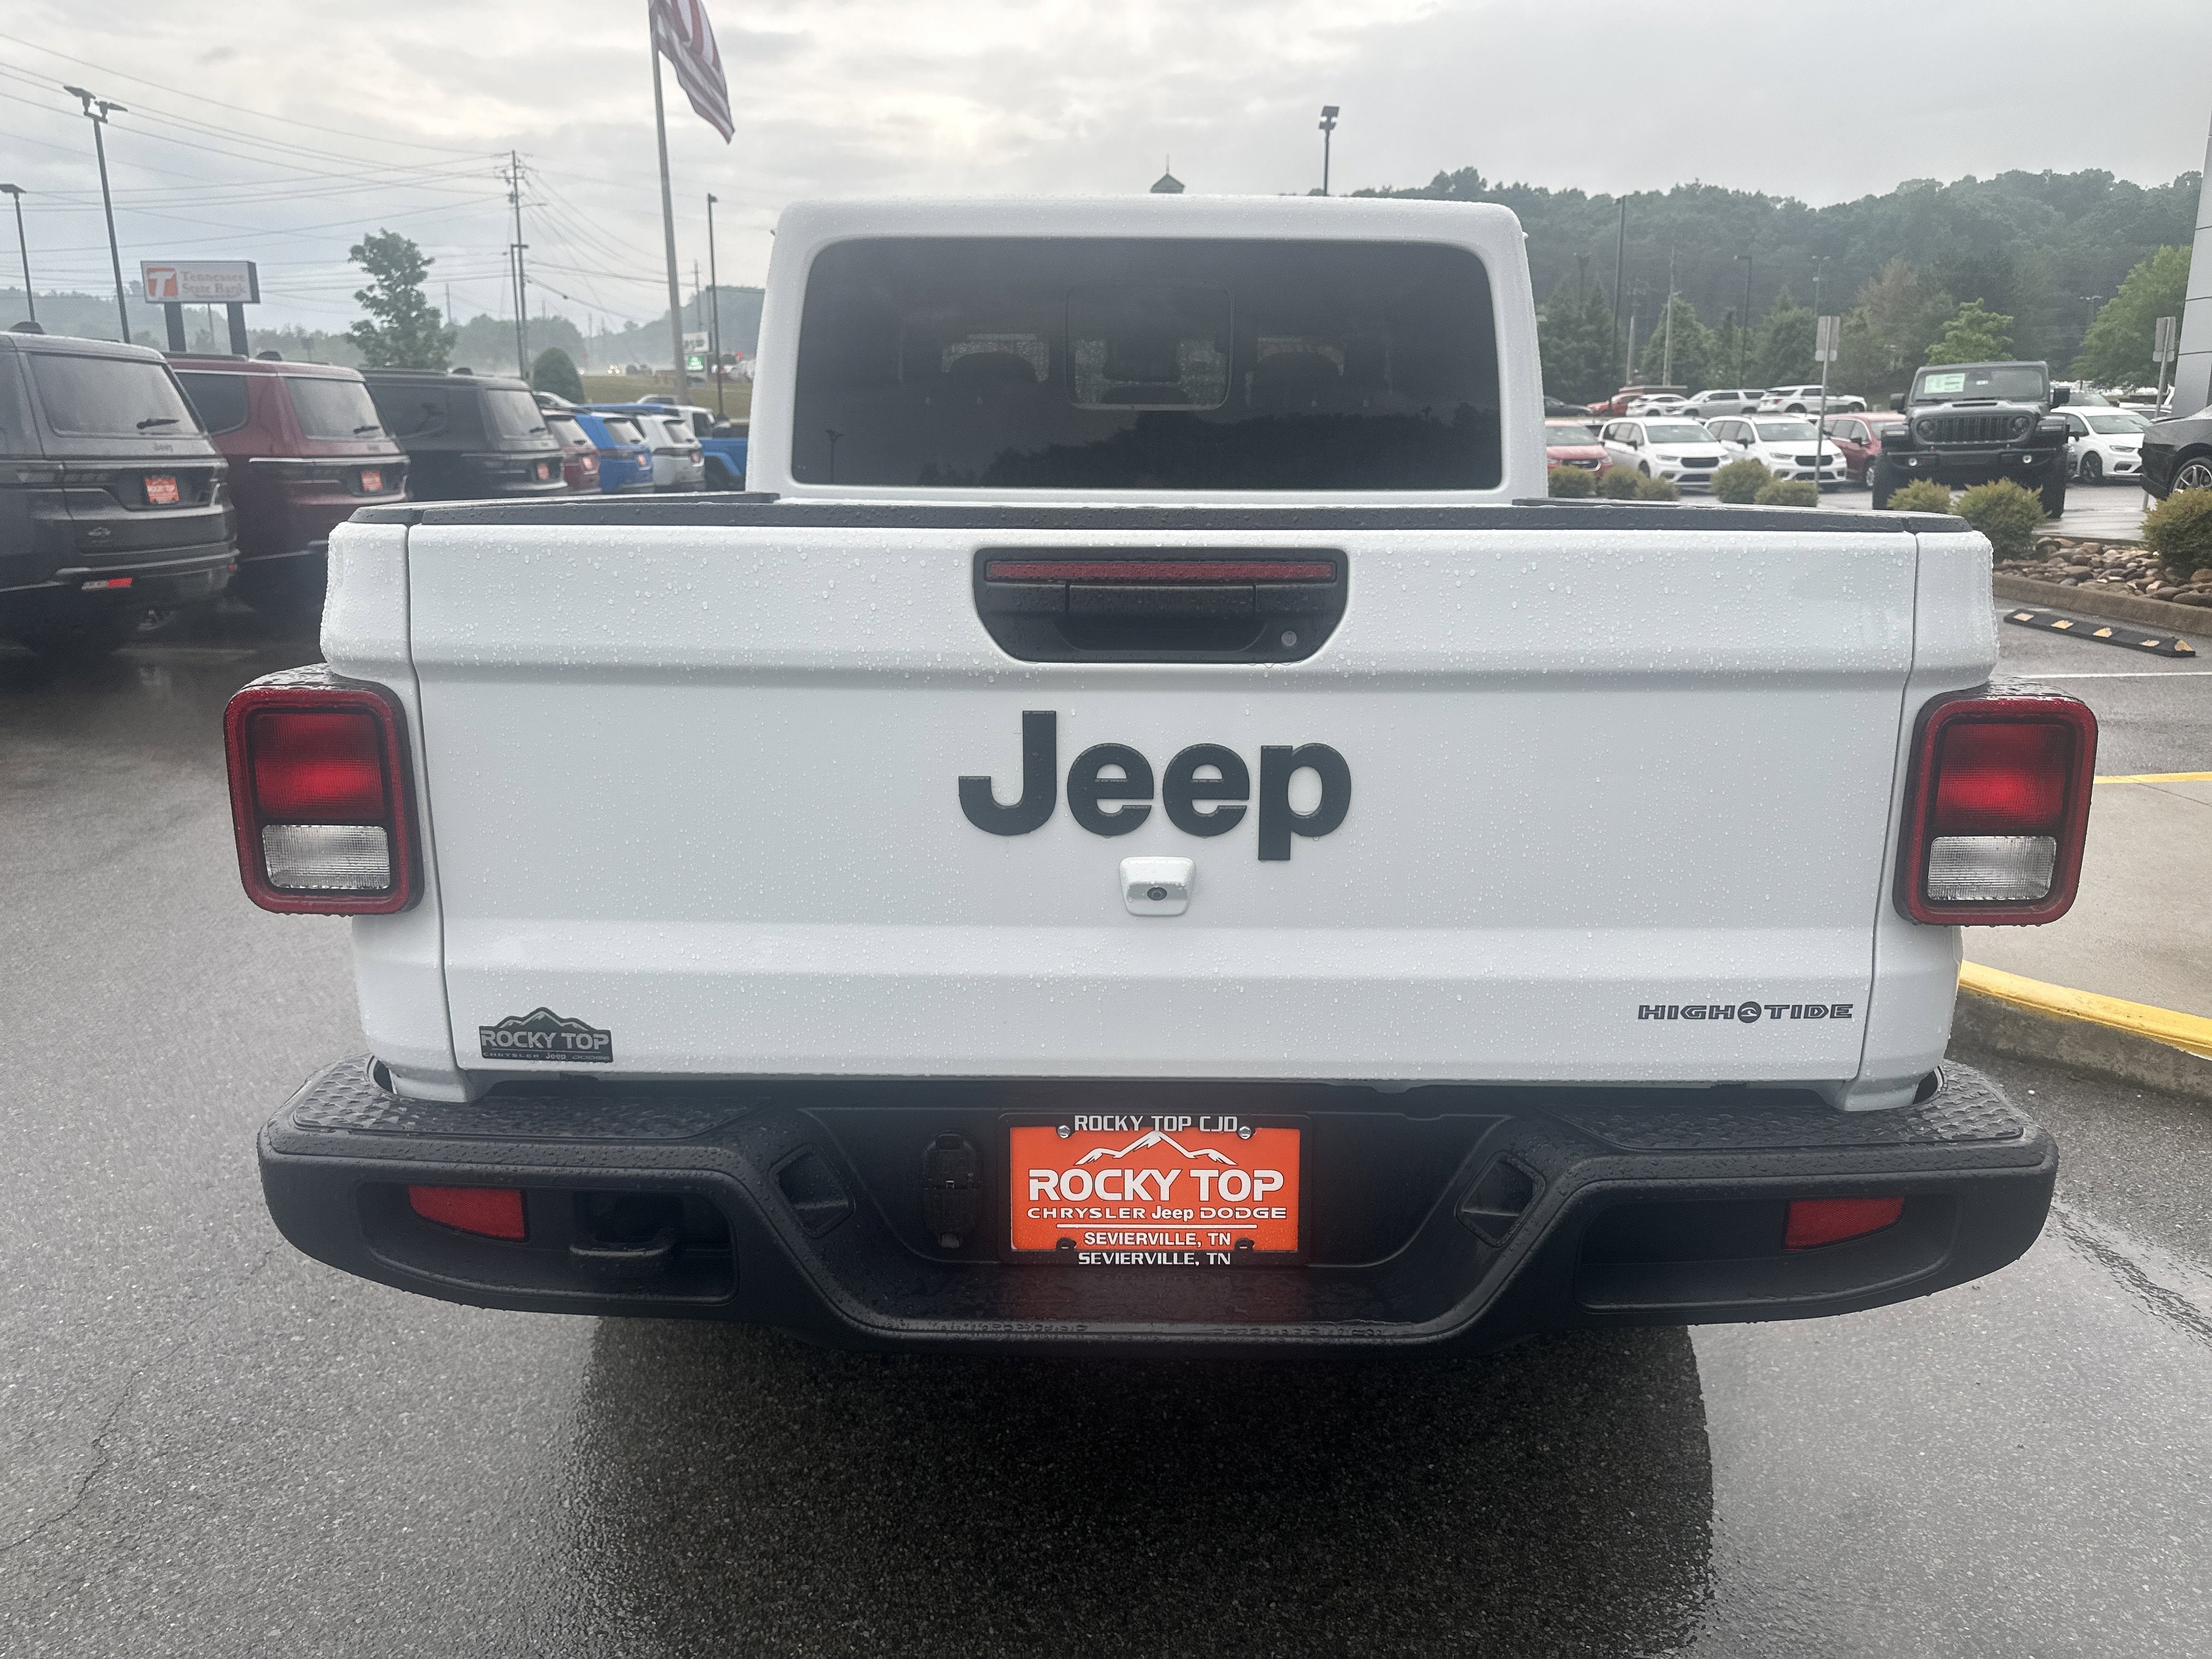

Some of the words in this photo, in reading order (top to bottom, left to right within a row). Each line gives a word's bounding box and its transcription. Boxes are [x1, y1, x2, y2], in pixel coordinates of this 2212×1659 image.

[958, 710, 1352, 861] Jeep
[1638, 1005, 1736, 1020] HIGH
[1764, 1004, 1854, 1019] TIDE
[481, 1030, 557, 1048] ROCKY
[562, 1032, 609, 1049] TOP
[1075, 1115, 1144, 1132] ROCKY
[1152, 1116, 1192, 1132] TOP
[1199, 1116, 1238, 1132] CJD
[1029, 1169, 1183, 1202] ROCKY
[1189, 1169, 1285, 1202] TOP
[1027, 1207, 1146, 1220] CHRYSLER
[1151, 1206, 1193, 1222] Jeep
[1199, 1207, 1286, 1219] DODGE
[1084, 1232, 1201, 1248] SEVIERVILLE,
[1209, 1232, 1231, 1245] TN
[1079, 1252, 1200, 1267] SEVIERVILLE,
[1206, 1252, 1231, 1265] TN
